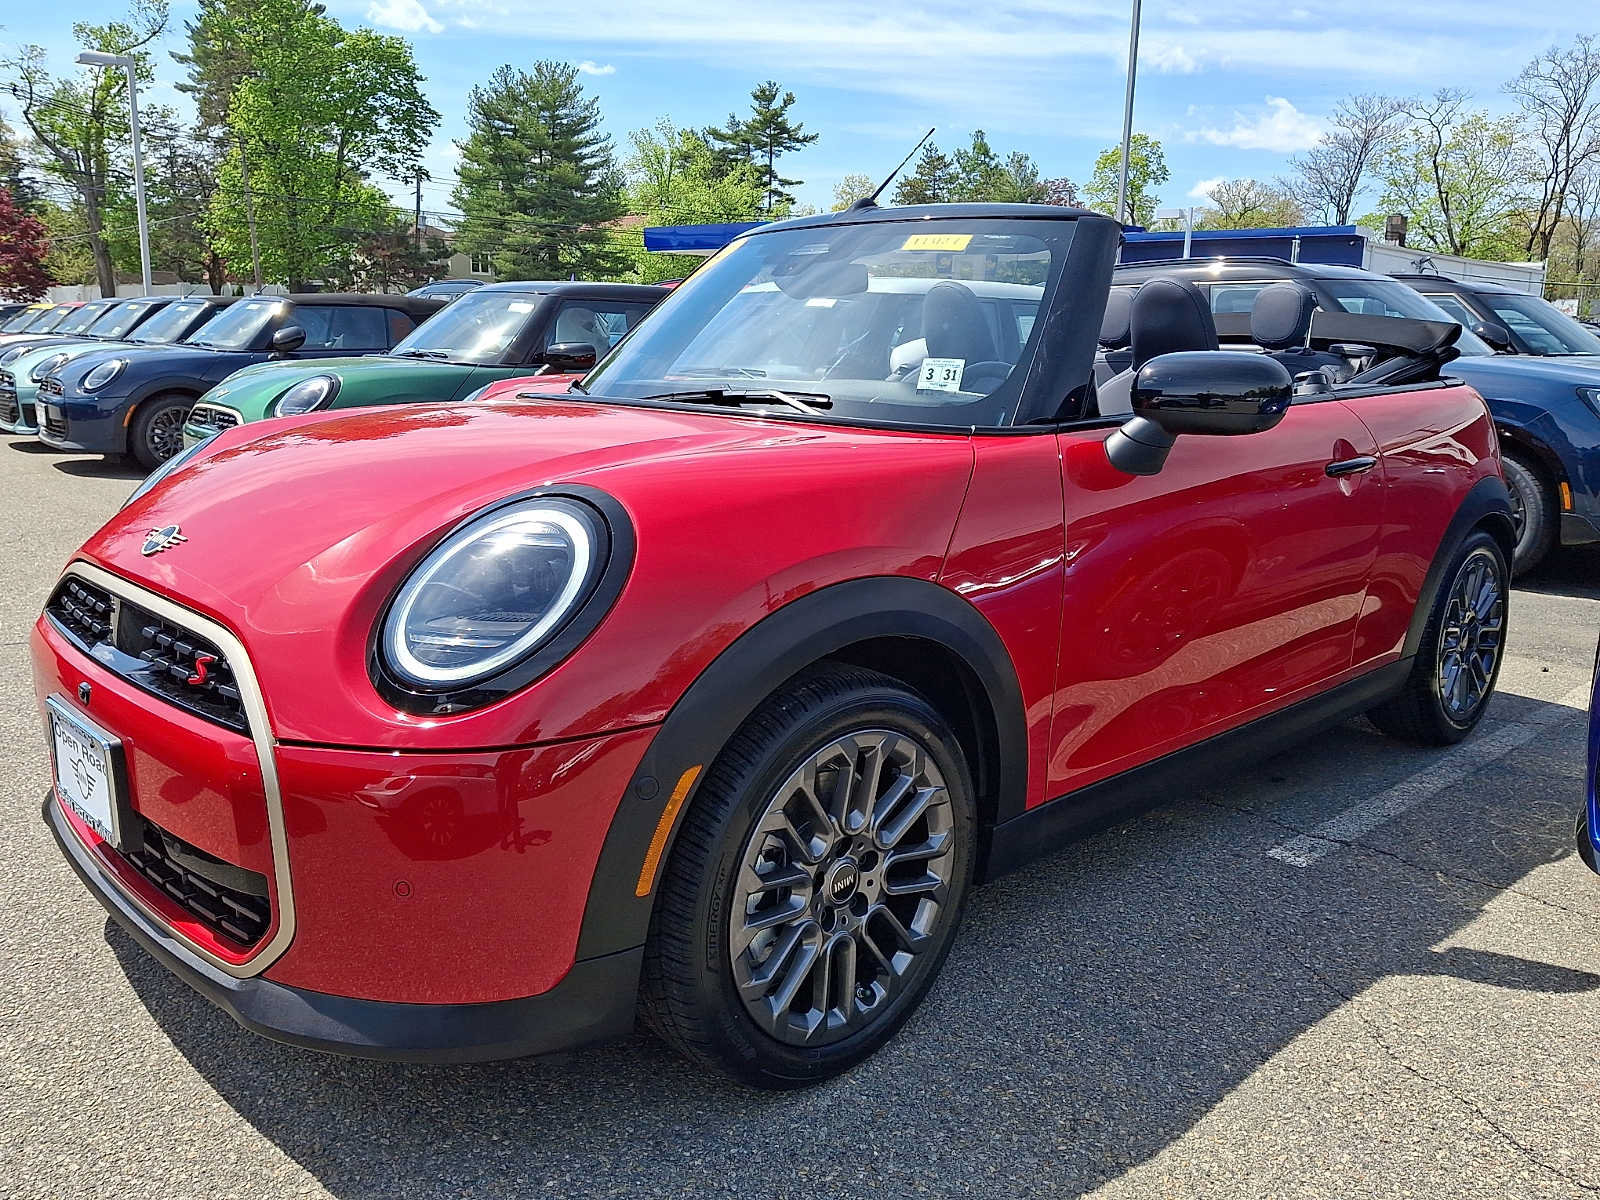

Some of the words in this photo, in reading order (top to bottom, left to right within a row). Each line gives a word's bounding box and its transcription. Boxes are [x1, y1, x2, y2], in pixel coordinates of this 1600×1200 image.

[926, 368, 934, 380] 3
[943, 369, 957, 380] 31
[187, 656, 214, 685] S
[54, 721, 79, 753] Open
[834, 874, 854, 893] MINI
